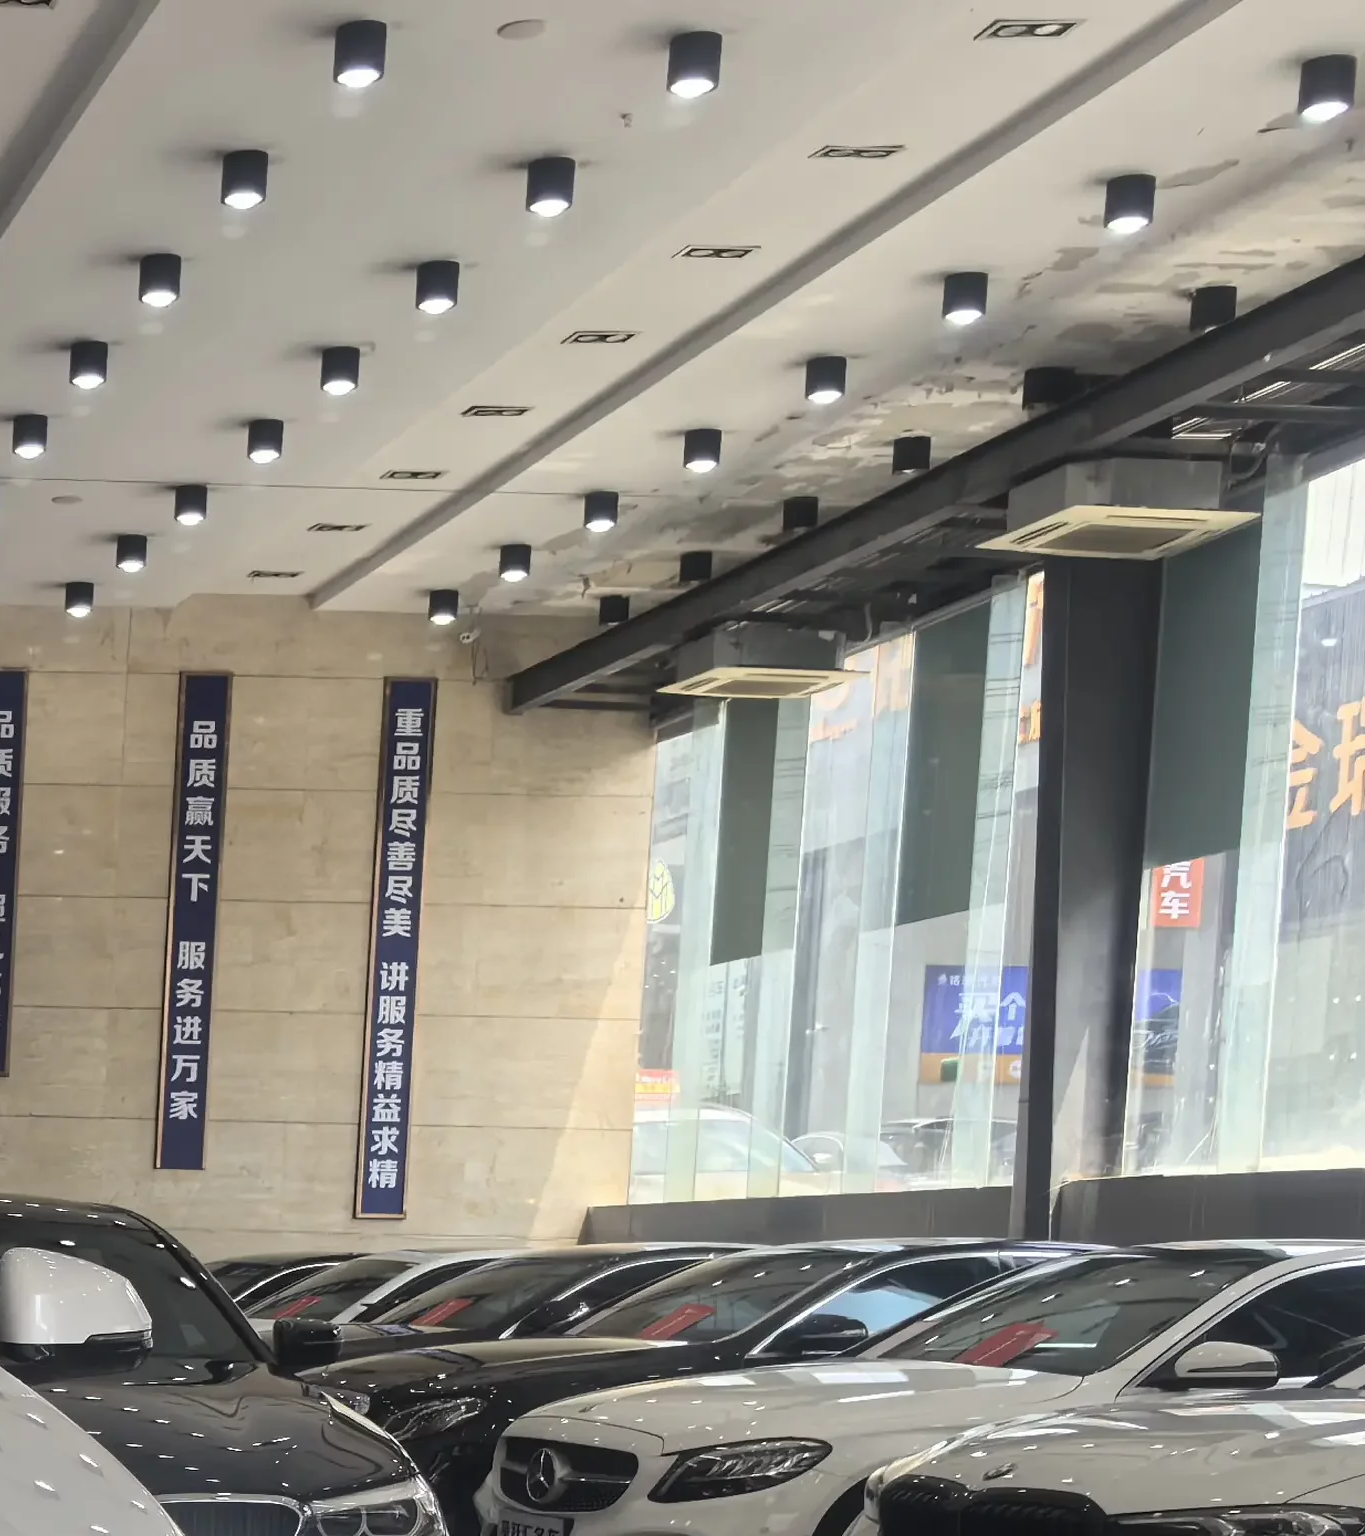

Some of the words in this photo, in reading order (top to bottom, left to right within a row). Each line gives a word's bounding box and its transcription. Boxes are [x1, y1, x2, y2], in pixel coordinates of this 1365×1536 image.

[182, 719, 218, 903] 品质赢天下
[381, 707, 425, 938] 重品质尽善尽美
[169, 939, 207, 1121] 服务进万家
[368, 961, 410, 1189] 讲服务精益求精
